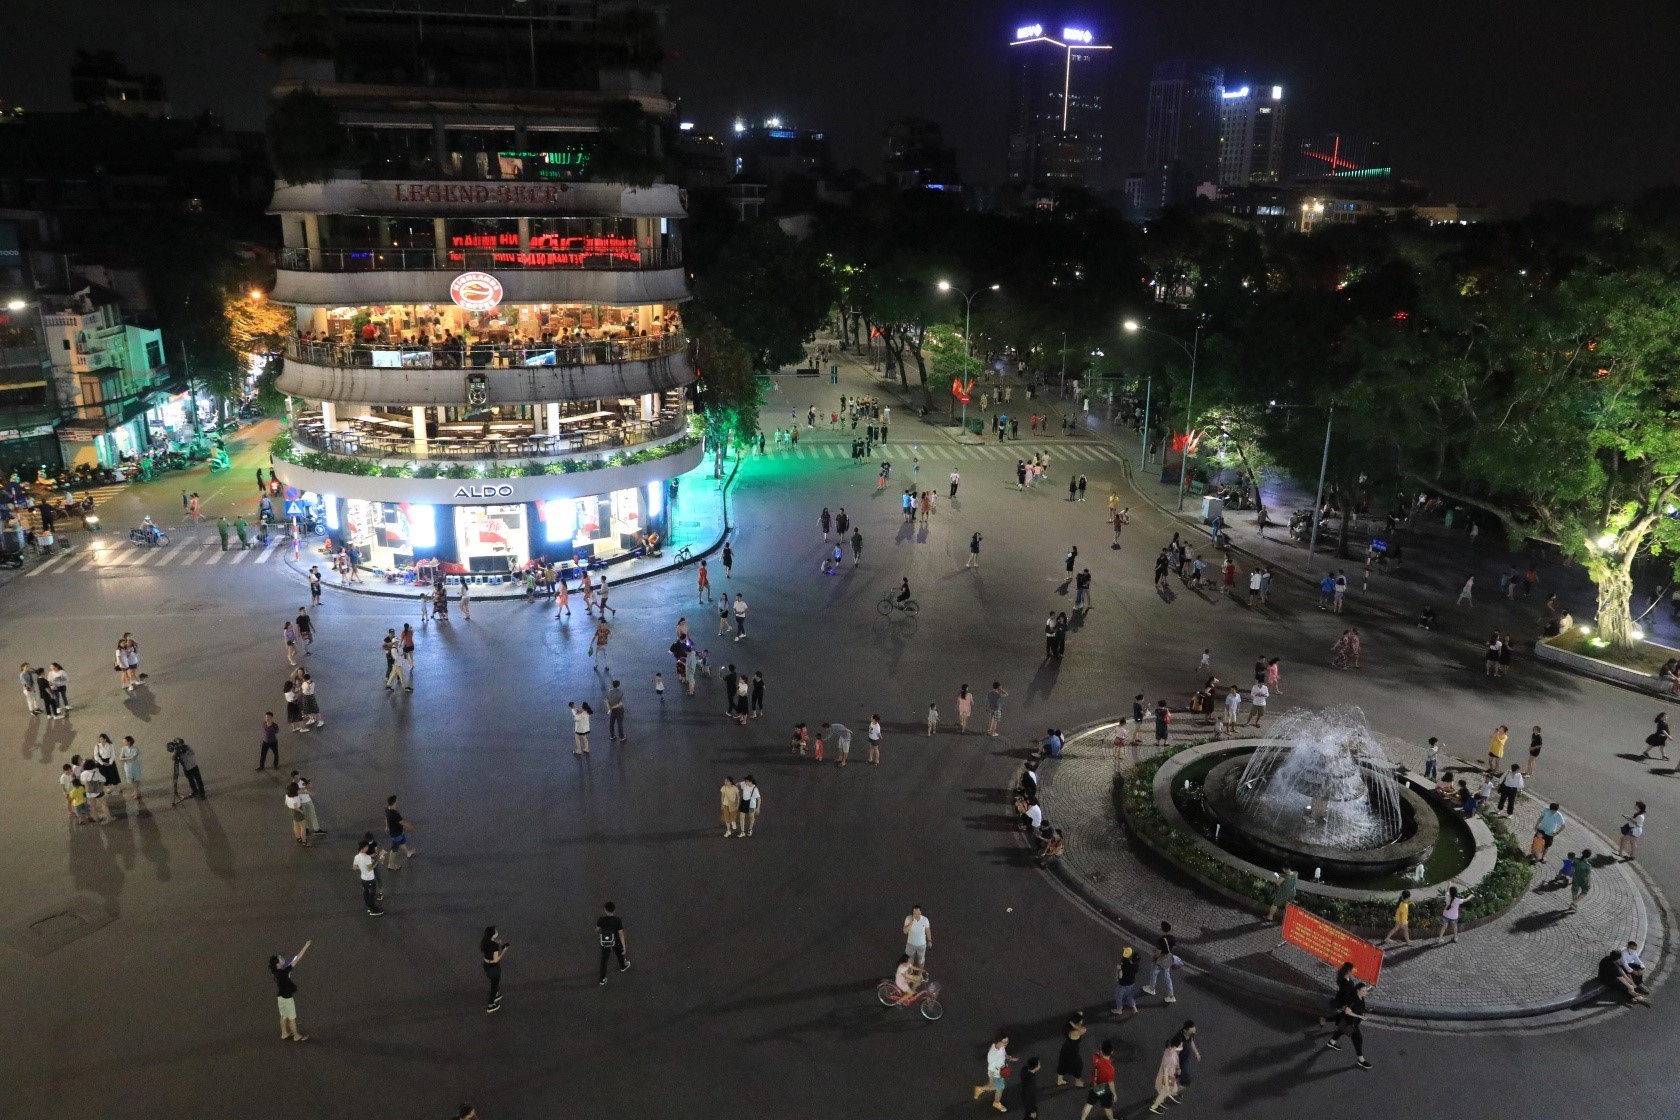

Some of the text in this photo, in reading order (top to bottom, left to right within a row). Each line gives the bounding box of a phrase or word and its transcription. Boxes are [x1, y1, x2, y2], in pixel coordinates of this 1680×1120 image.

[395, 184, 559, 205] LEGEND BEER
[454, 485, 513, 498] ALDO
